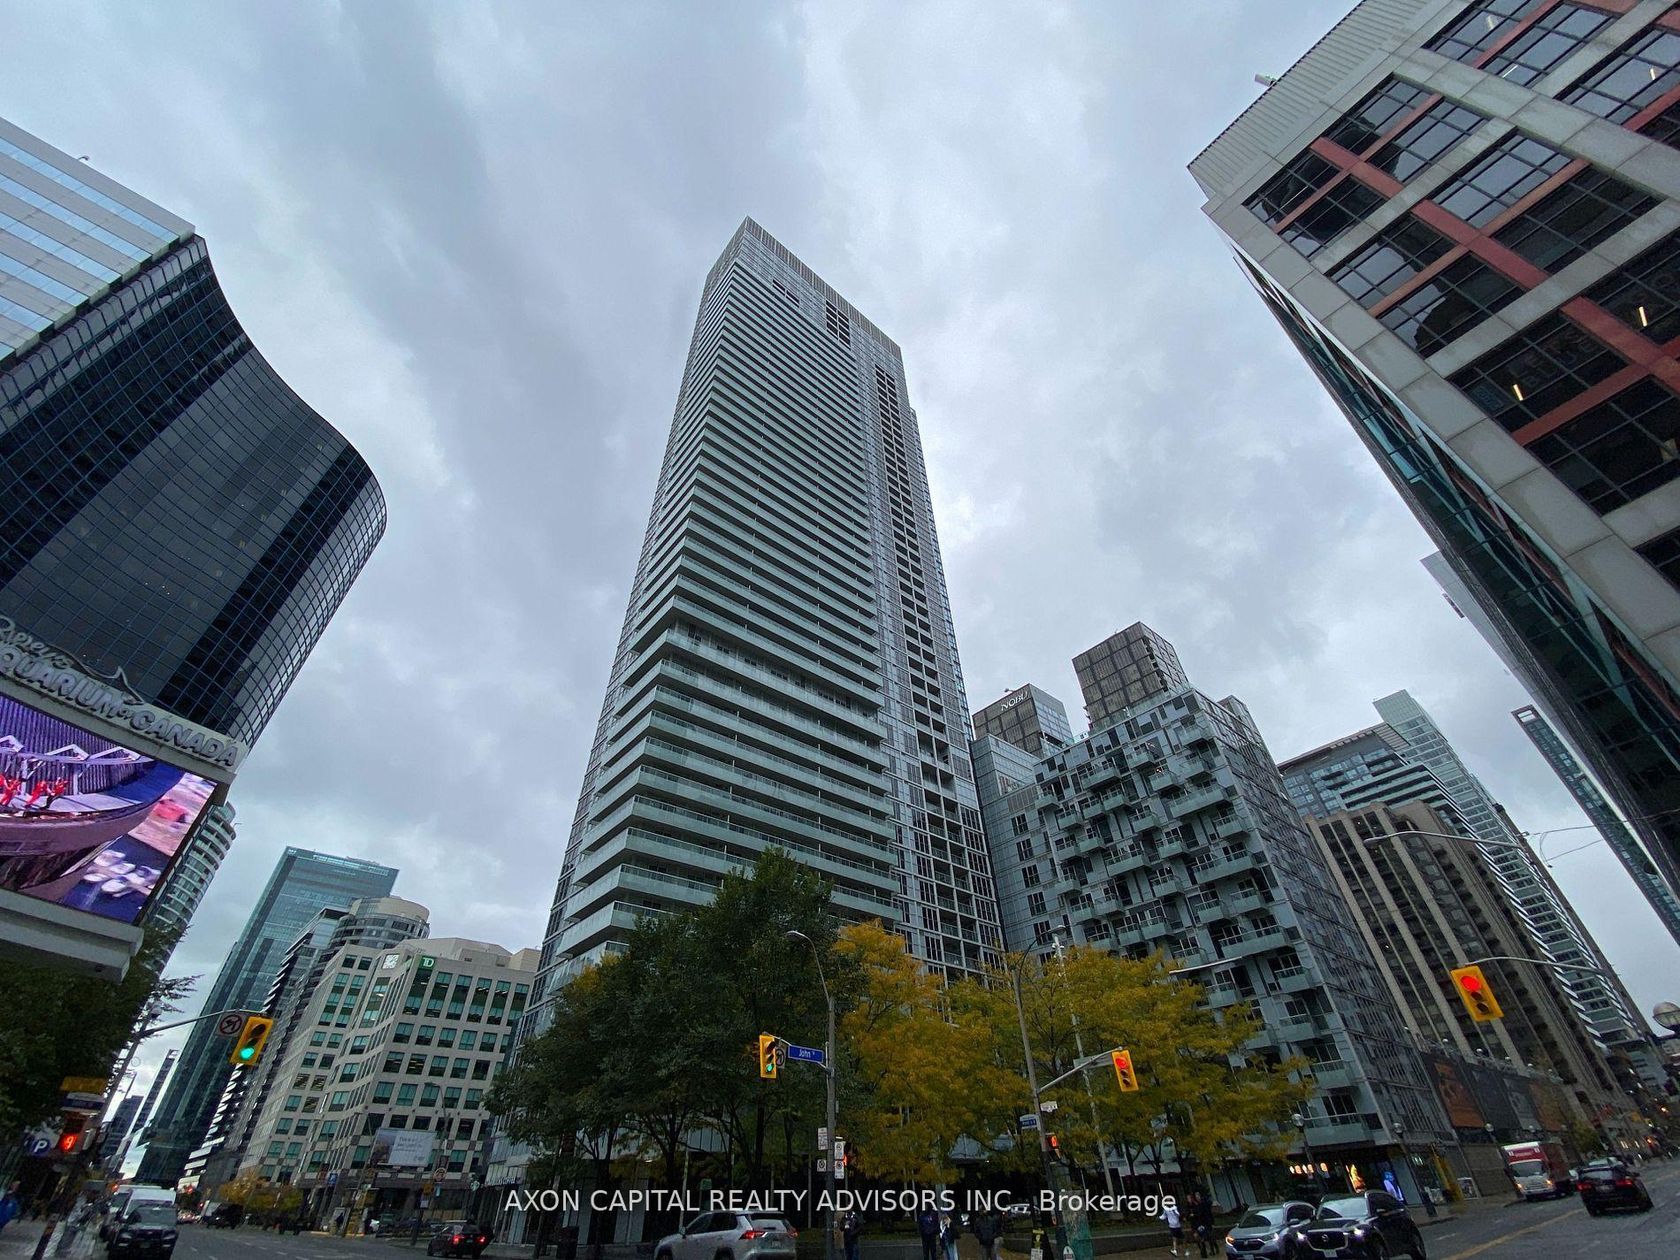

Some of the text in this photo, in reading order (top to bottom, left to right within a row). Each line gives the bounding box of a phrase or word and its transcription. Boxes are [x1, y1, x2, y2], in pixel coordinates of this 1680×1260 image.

[0, 644, 123, 719] QUARIUM
[130, 710, 239, 767] CANADA
[422, 957, 435, 968] TD
[799, 1049, 811, 1059] John
